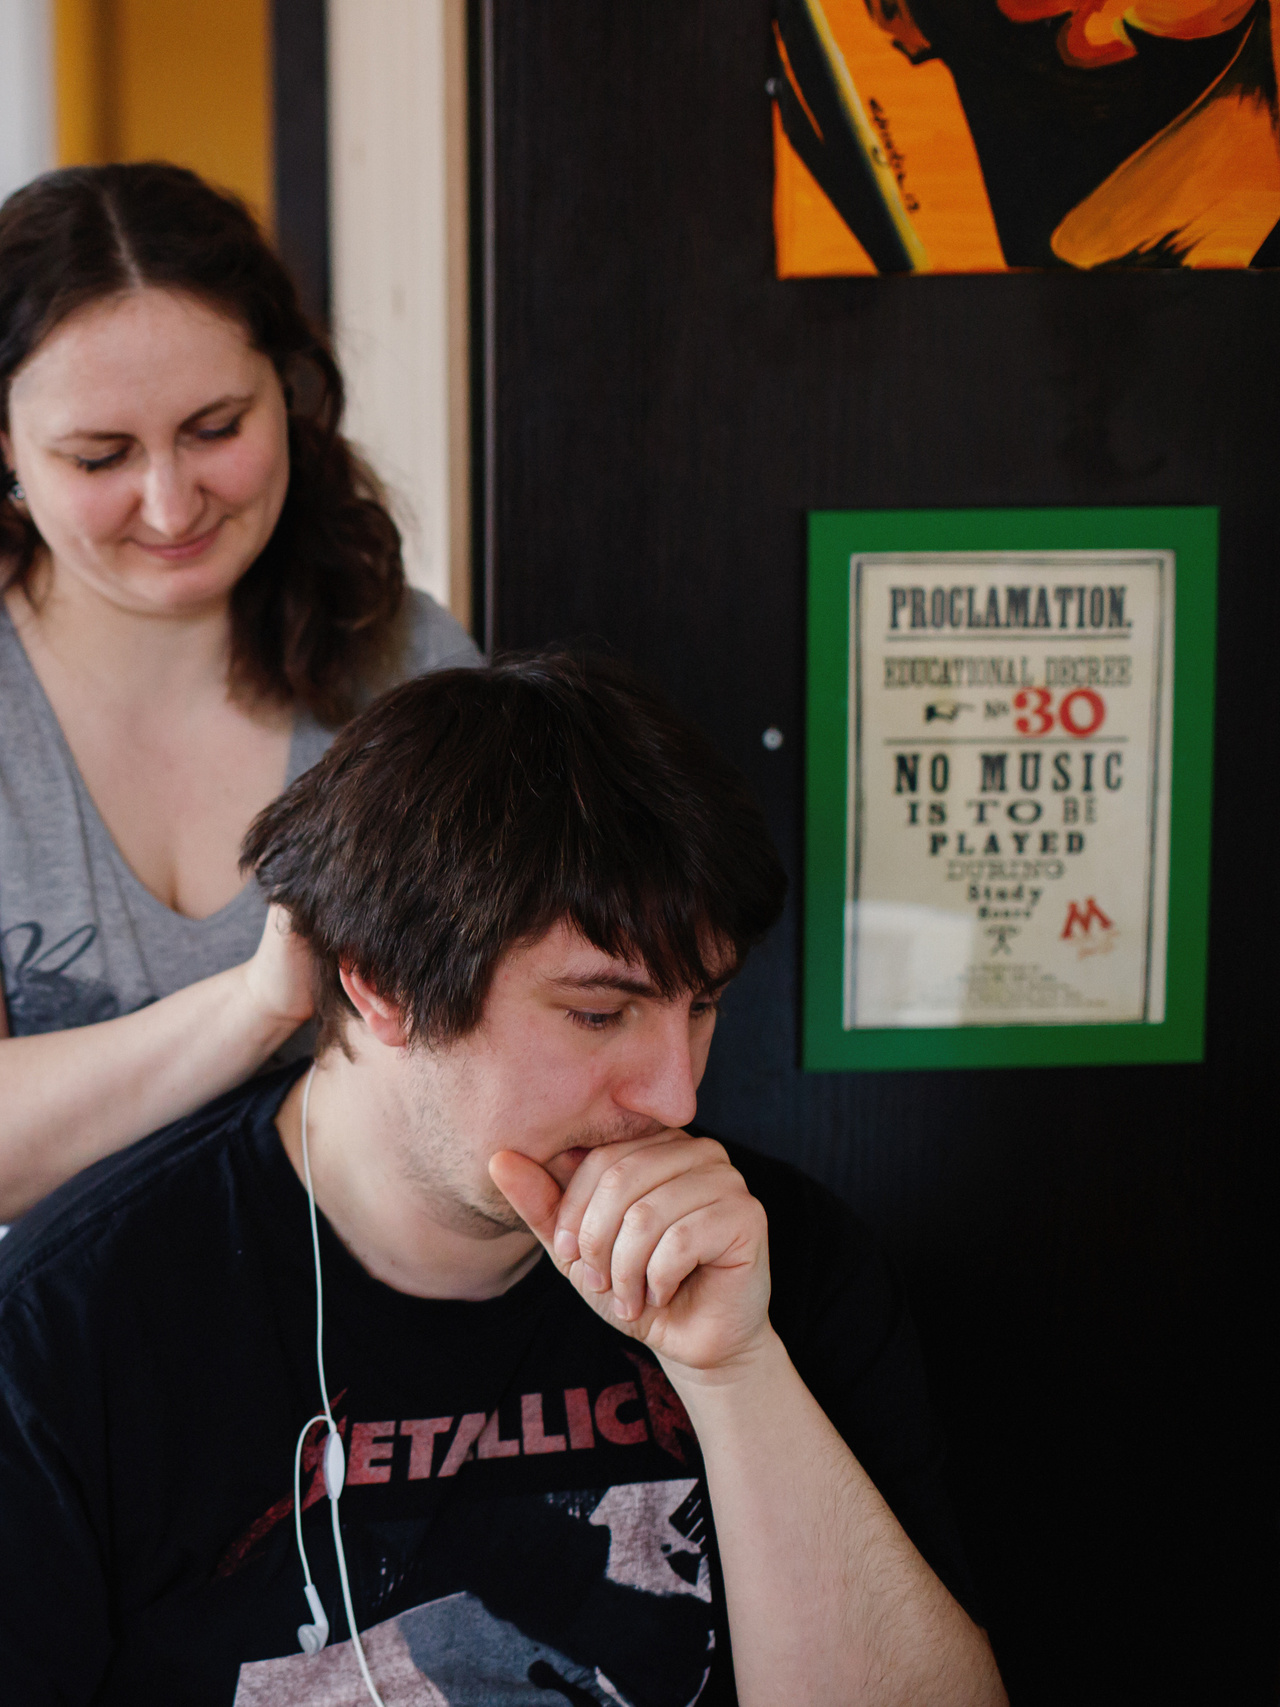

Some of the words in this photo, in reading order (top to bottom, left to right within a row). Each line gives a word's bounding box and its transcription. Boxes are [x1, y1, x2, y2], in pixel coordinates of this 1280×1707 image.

[889, 585, 1132, 629] PROCLAMATION.
[883, 657, 1033, 688] EDUCATIONAL
[1045, 655, 1132, 687] DECREE
[1013, 686, 1106, 739] 30
[894, 753, 950, 795] NO
[981, 752, 1124, 793] MUSIC
[908, 801, 947, 826] IS
[968, 799, 1043, 825] TO
[1063, 796, 1097, 824] BE
[930, 832, 1086, 856] PLAYED
